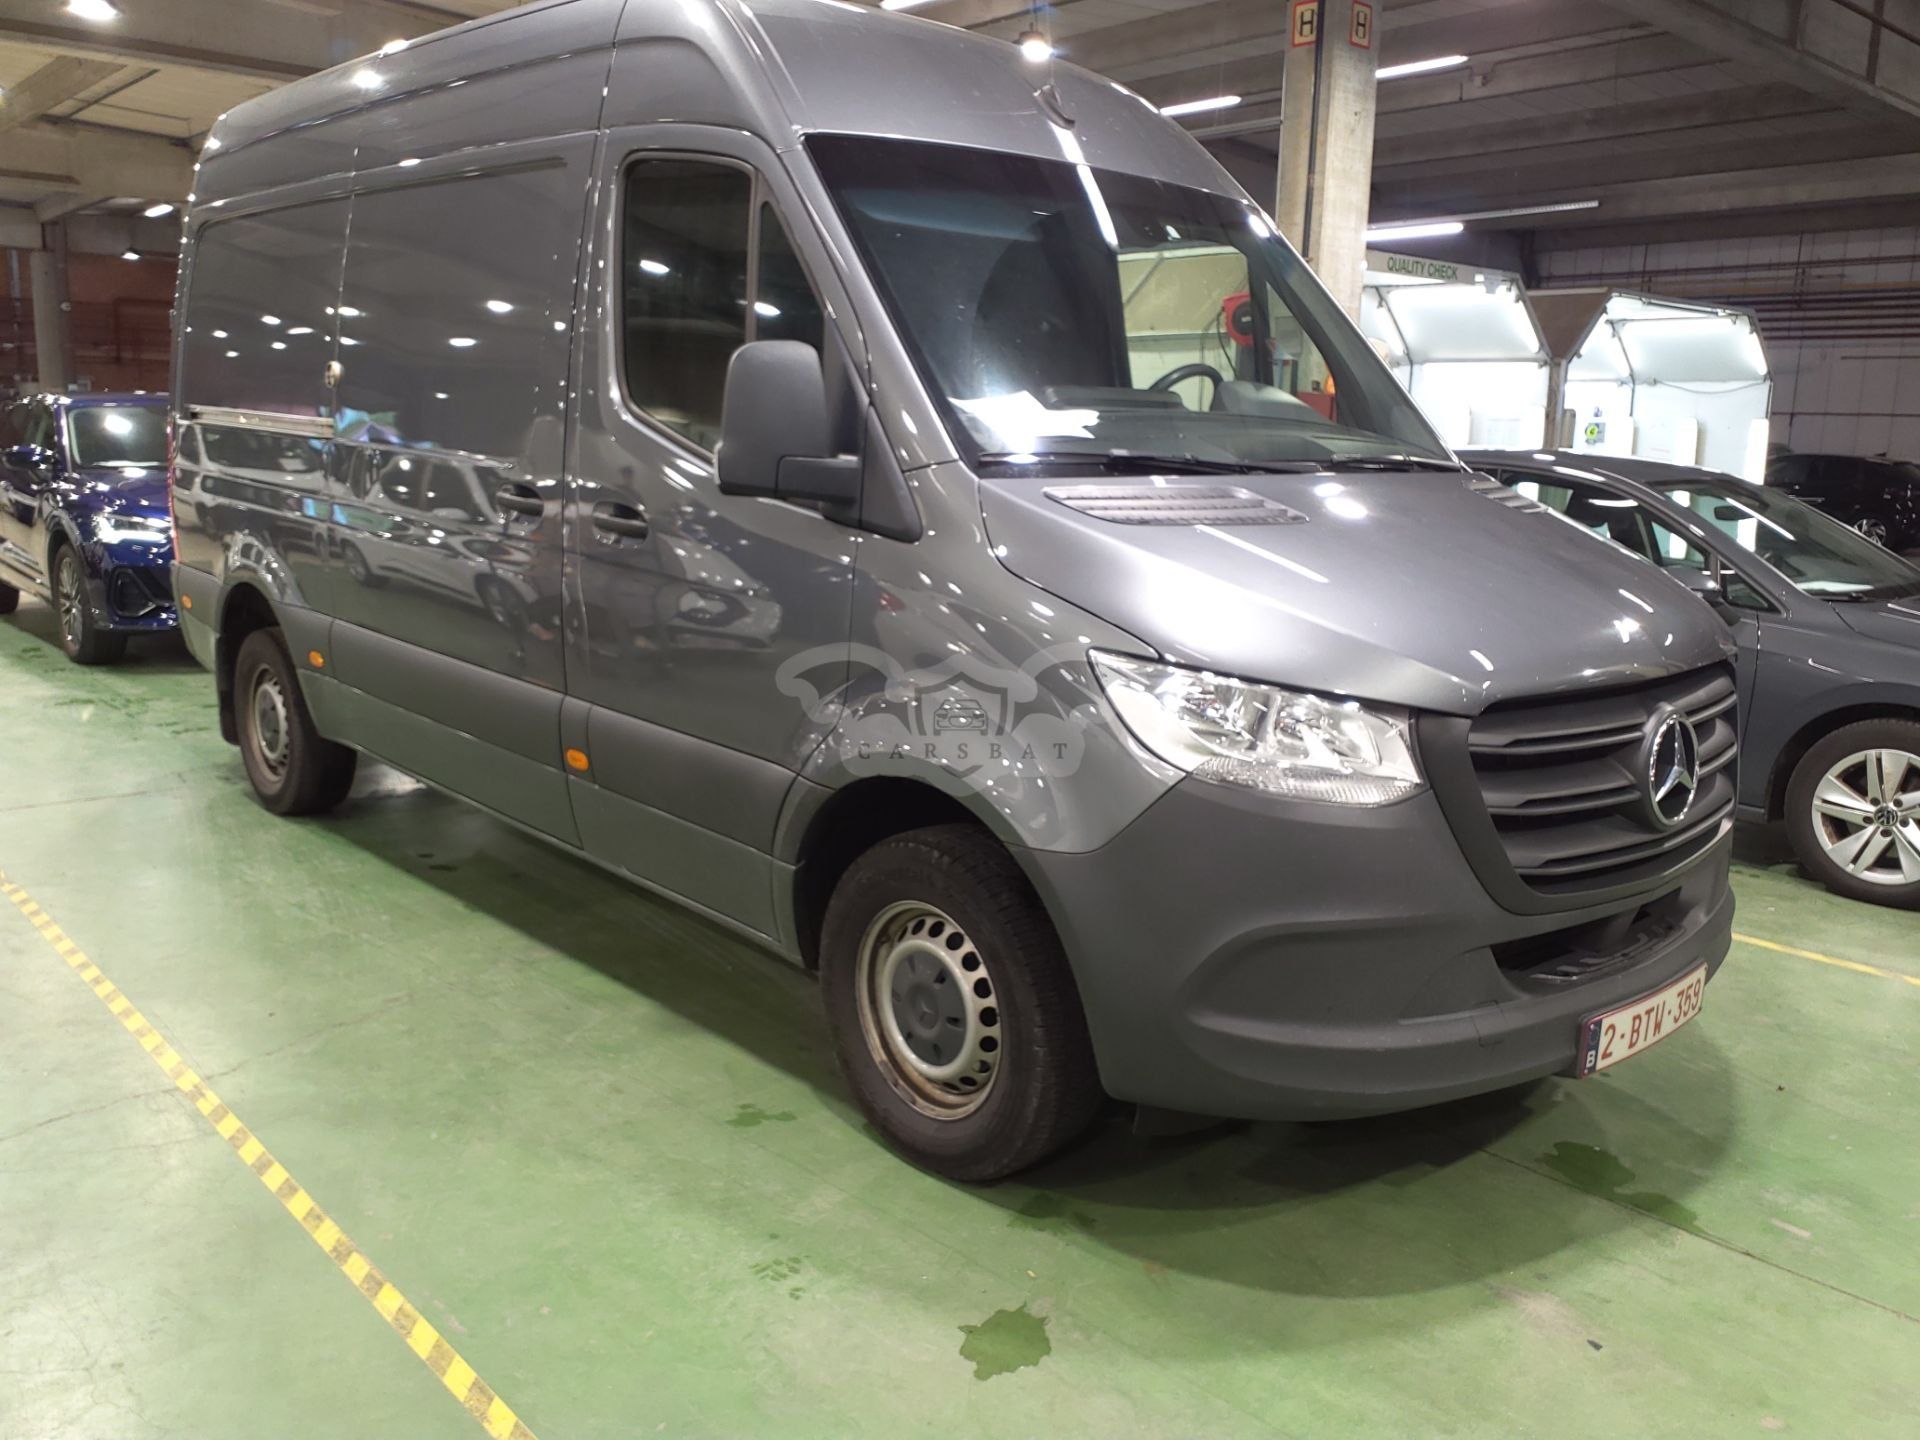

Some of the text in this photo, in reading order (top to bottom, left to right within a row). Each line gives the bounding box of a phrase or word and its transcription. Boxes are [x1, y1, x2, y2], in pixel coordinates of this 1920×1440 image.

[1387, 256, 1458, 281] QUALITY CHECK
[1586, 1050, 1596, 1068] B
